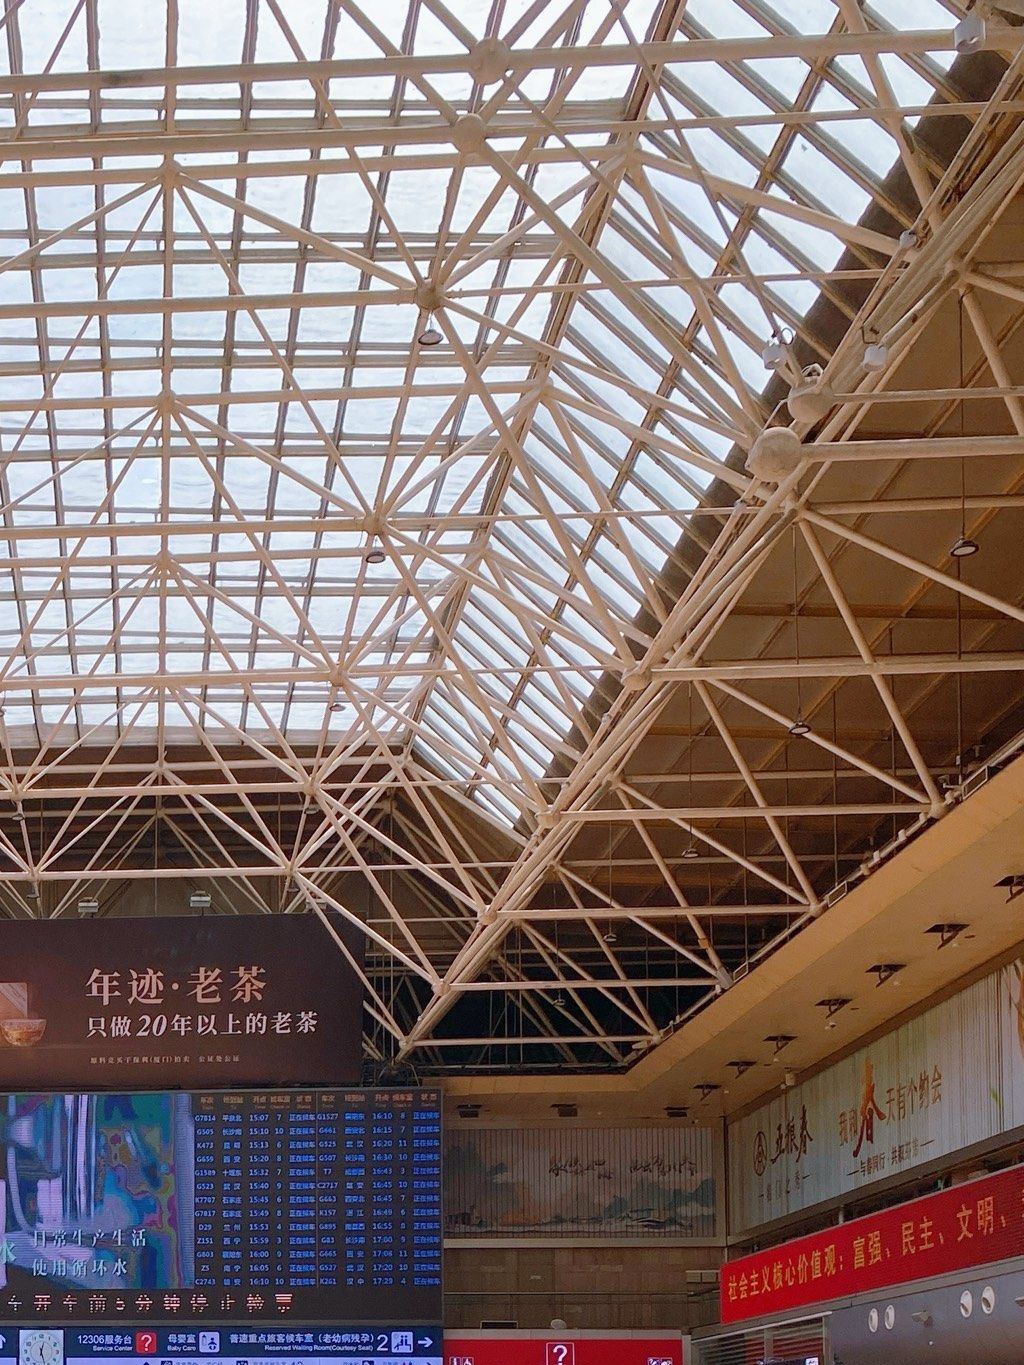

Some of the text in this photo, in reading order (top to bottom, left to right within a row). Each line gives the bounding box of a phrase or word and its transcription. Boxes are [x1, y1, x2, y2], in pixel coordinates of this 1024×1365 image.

[85, 966, 267, 1006] 年迹·老茶
[86, 1011, 319, 1038] 只做20年以上的老茶
[32, 1228, 147, 1248] 日常生产生活
[32, 1257, 129, 1278] 使用循环水
[78, 1334, 132, 1344] 12306服务台
[168, 1334, 196, 1344] 母婴室
[377, 1335, 389, 1351] 2
